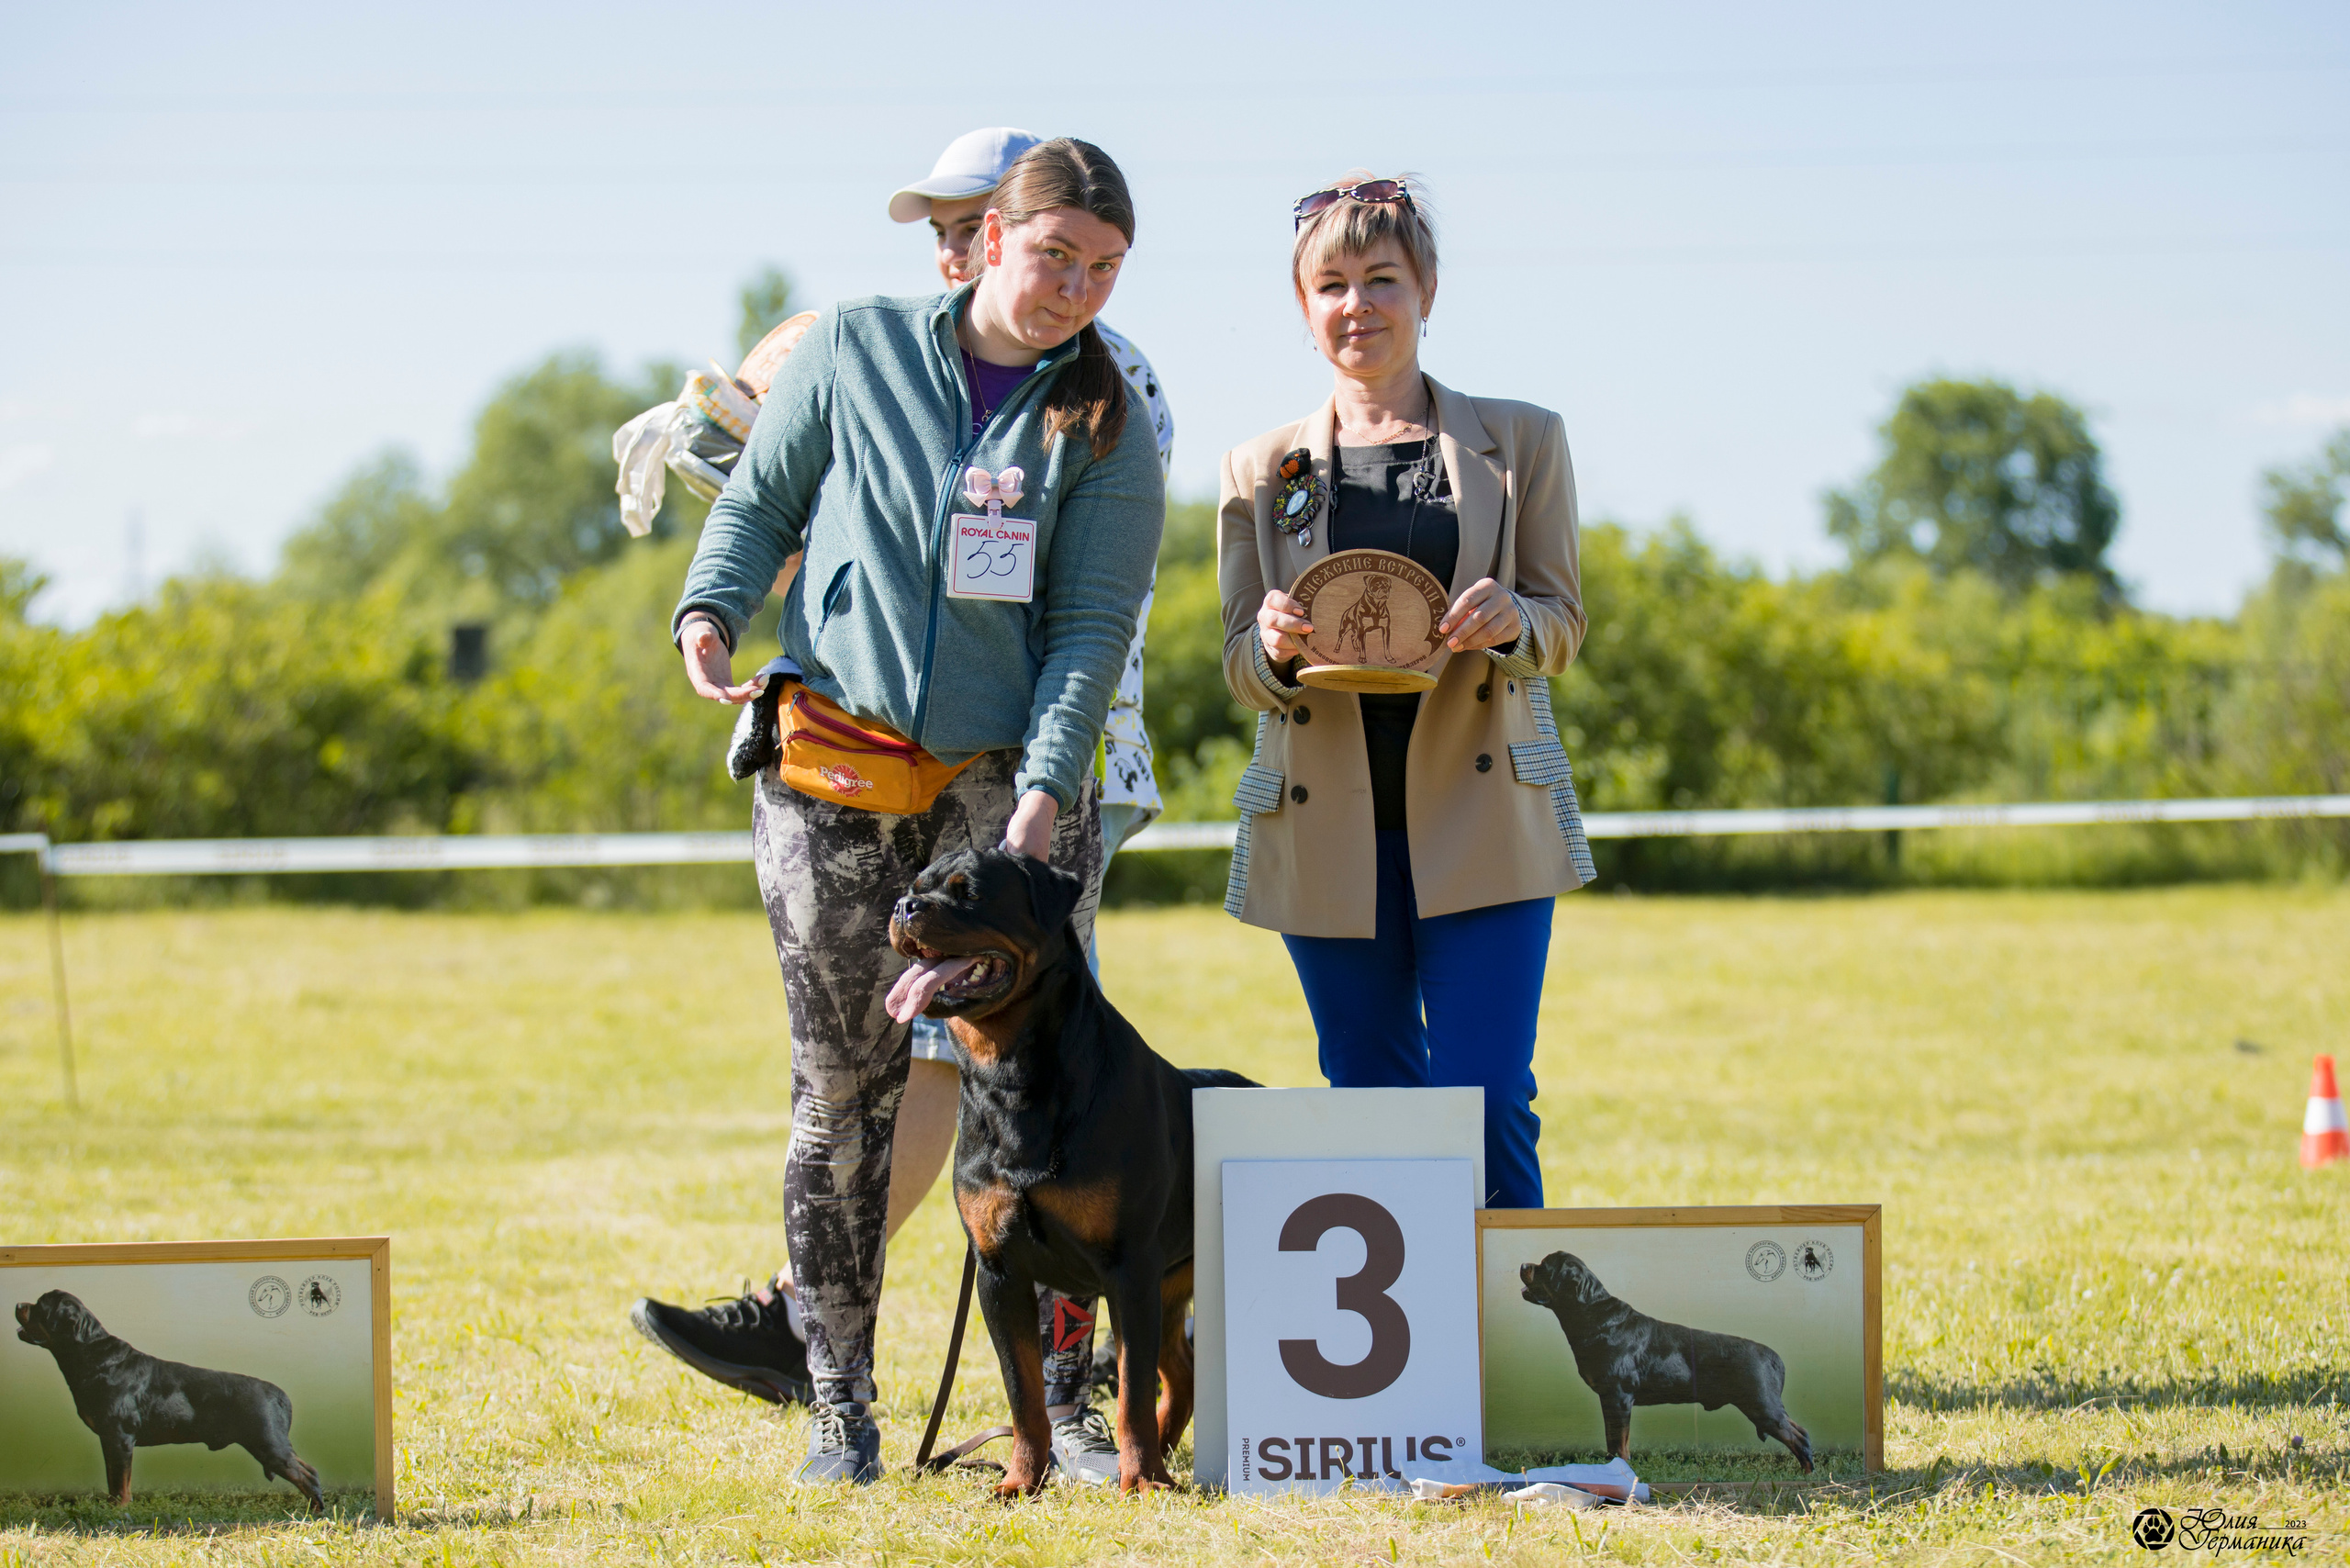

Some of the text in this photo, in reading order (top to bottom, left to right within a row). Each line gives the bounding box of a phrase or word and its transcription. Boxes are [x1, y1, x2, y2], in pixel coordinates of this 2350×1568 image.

[961, 527, 1030, 542] ROYAL CANIN
[967, 540, 1024, 579] 55
[1297, 556, 1372, 619] РОНЕЖСКИЕ
[819, 765, 873, 790] Pedigree
[1278, 1193, 1411, 1400] 3
[1242, 1438, 1250, 1481] PREMIUM
